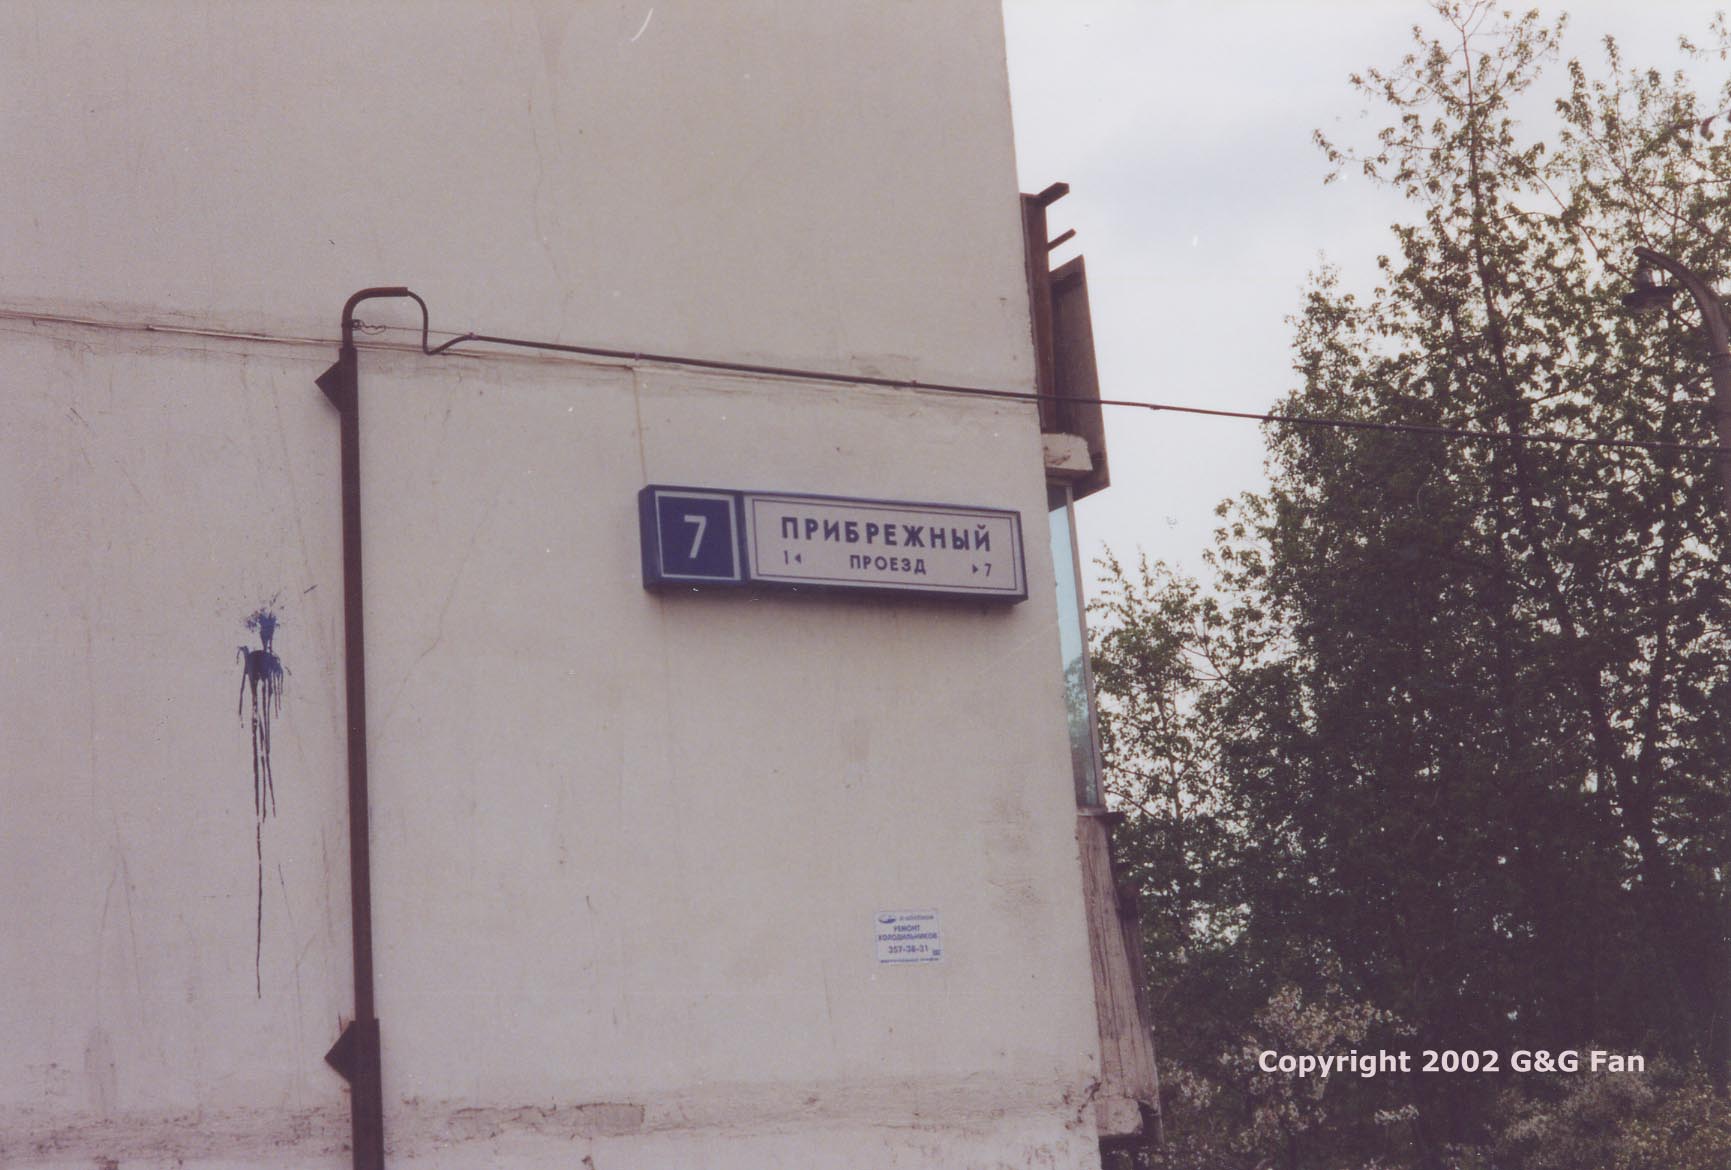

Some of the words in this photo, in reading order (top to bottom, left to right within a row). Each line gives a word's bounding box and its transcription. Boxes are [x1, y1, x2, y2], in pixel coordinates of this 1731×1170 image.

[683, 514, 708, 560] 7
[781, 516, 992, 552] ПРИБРЕЖНЫЙ
[783, 551, 790, 565] 1
[849, 554, 927, 575] ПРОЕЗД
[984, 563, 993, 577] 7
[893, 924, 921, 933] РЕМОНТ
